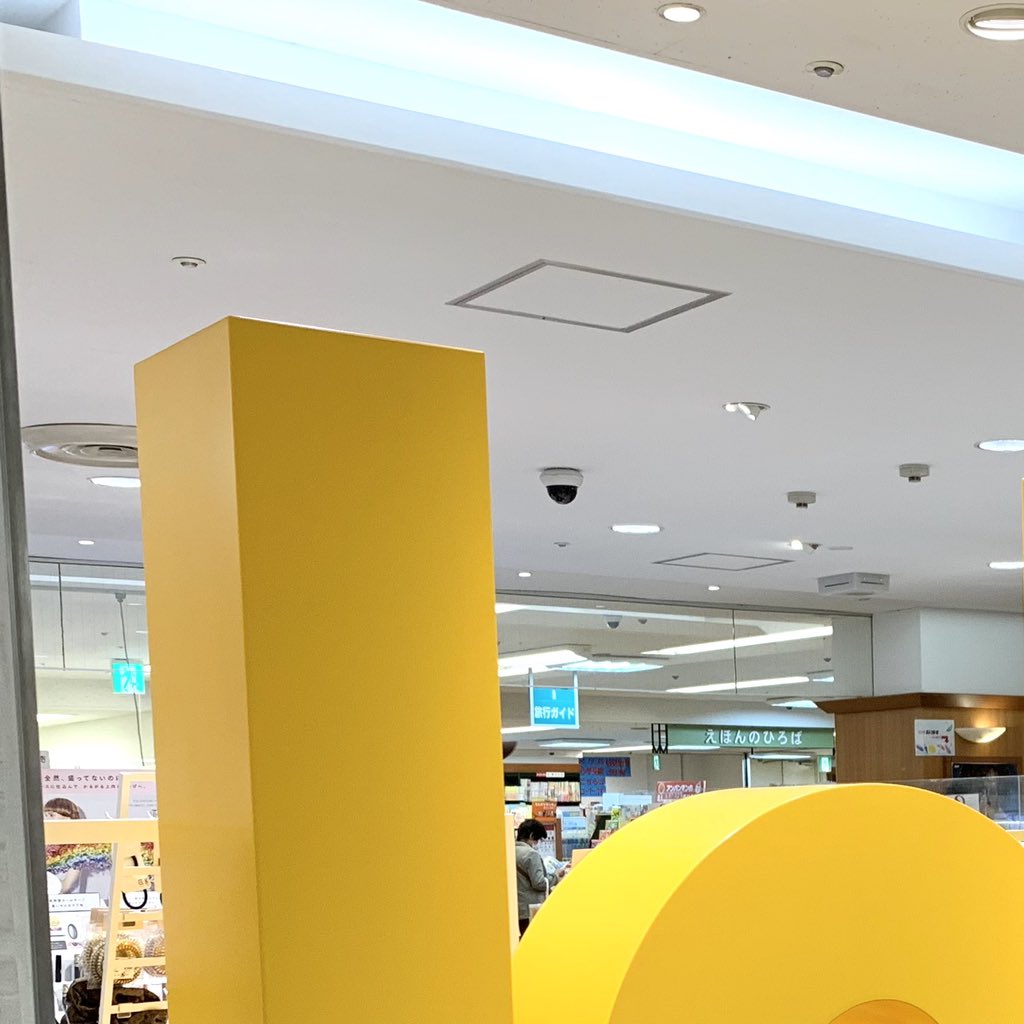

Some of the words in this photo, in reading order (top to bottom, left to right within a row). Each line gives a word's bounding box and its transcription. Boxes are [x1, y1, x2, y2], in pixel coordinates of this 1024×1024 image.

[534, 706, 575, 720] 旅行ガイド
[704, 728, 803, 746] えほんのひろば
